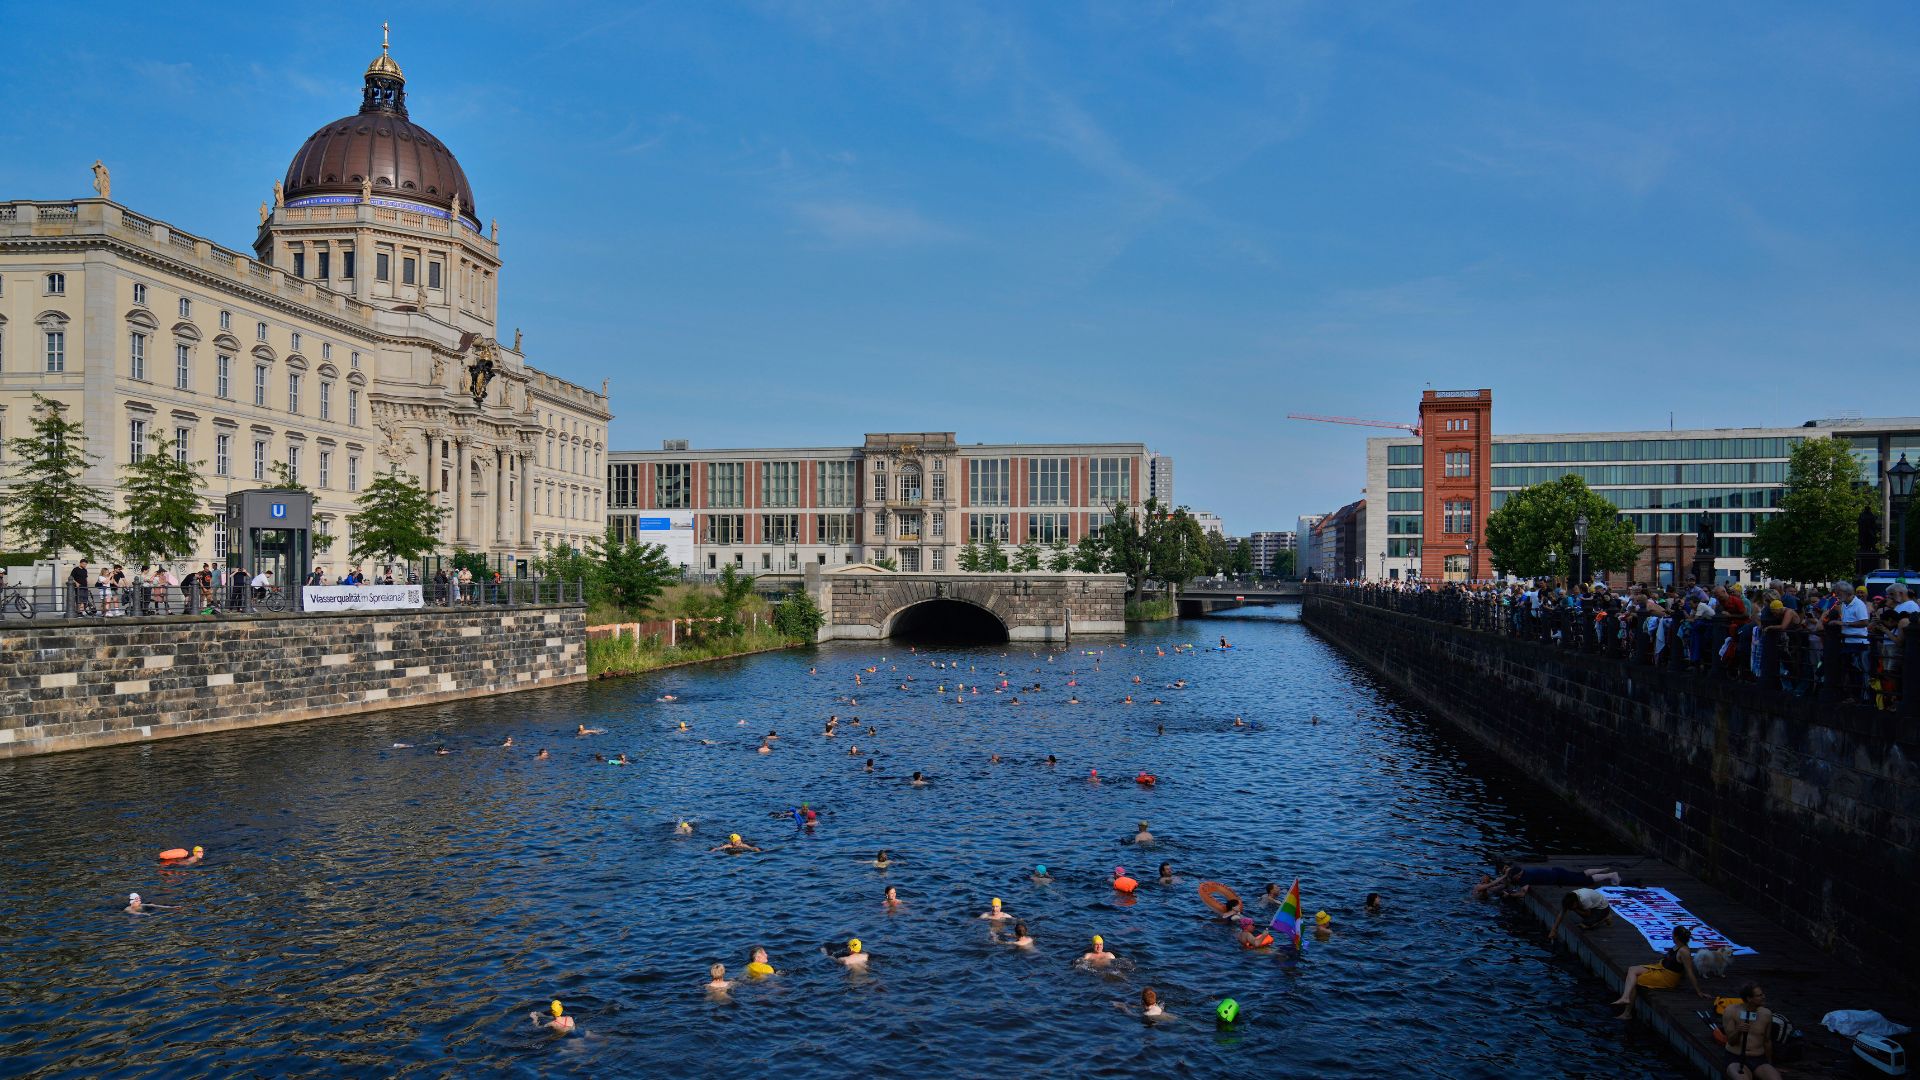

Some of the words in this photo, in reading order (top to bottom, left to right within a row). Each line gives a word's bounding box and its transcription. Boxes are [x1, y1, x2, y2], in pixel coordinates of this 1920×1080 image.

[273, 504, 284, 517] U
[310, 593, 360, 605] Wasserqualität
[361, 594, 369, 602] im
